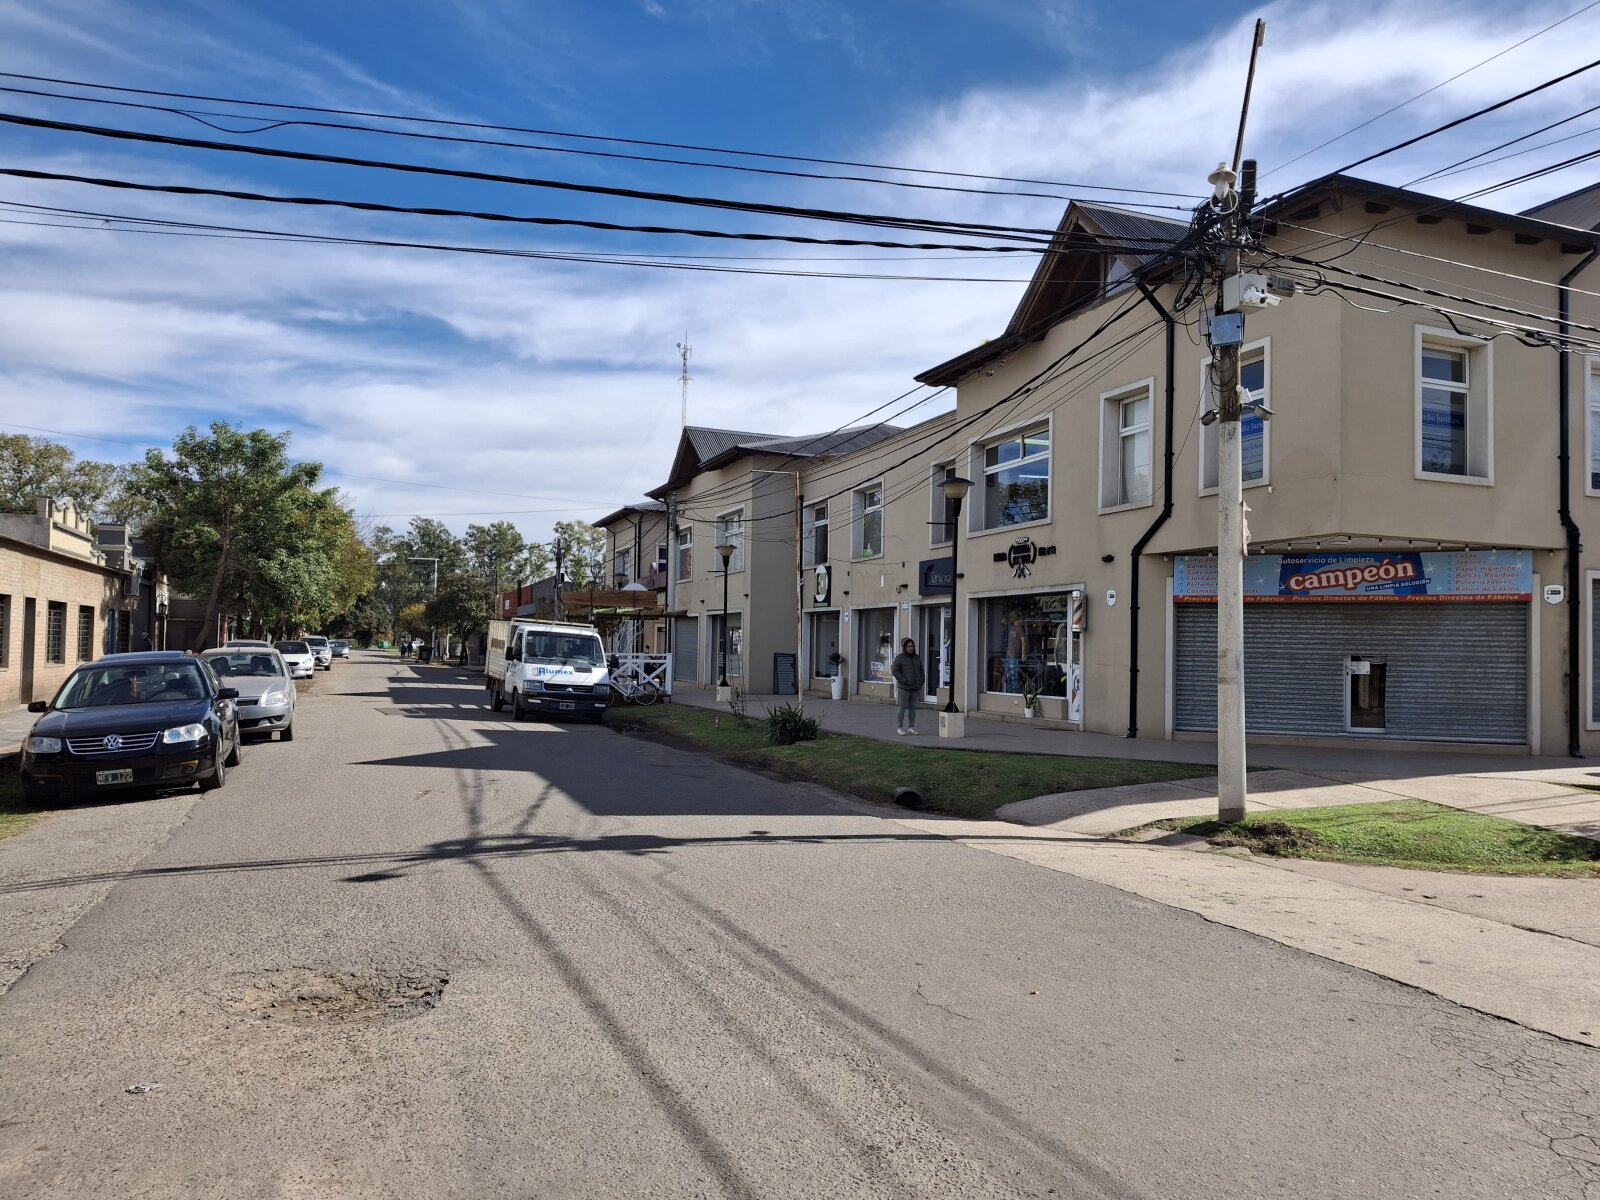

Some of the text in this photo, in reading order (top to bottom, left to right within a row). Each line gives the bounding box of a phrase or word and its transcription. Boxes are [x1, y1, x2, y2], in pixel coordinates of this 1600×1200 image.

[1278, 557, 1326, 565] Autoservicio
[1339, 556, 1375, 565] Limpieza
[1289, 558, 1415, 591] campeón
[1400, 579, 1430, 587] SOLUCIÓN
[538, 667, 573, 676] Alumex
